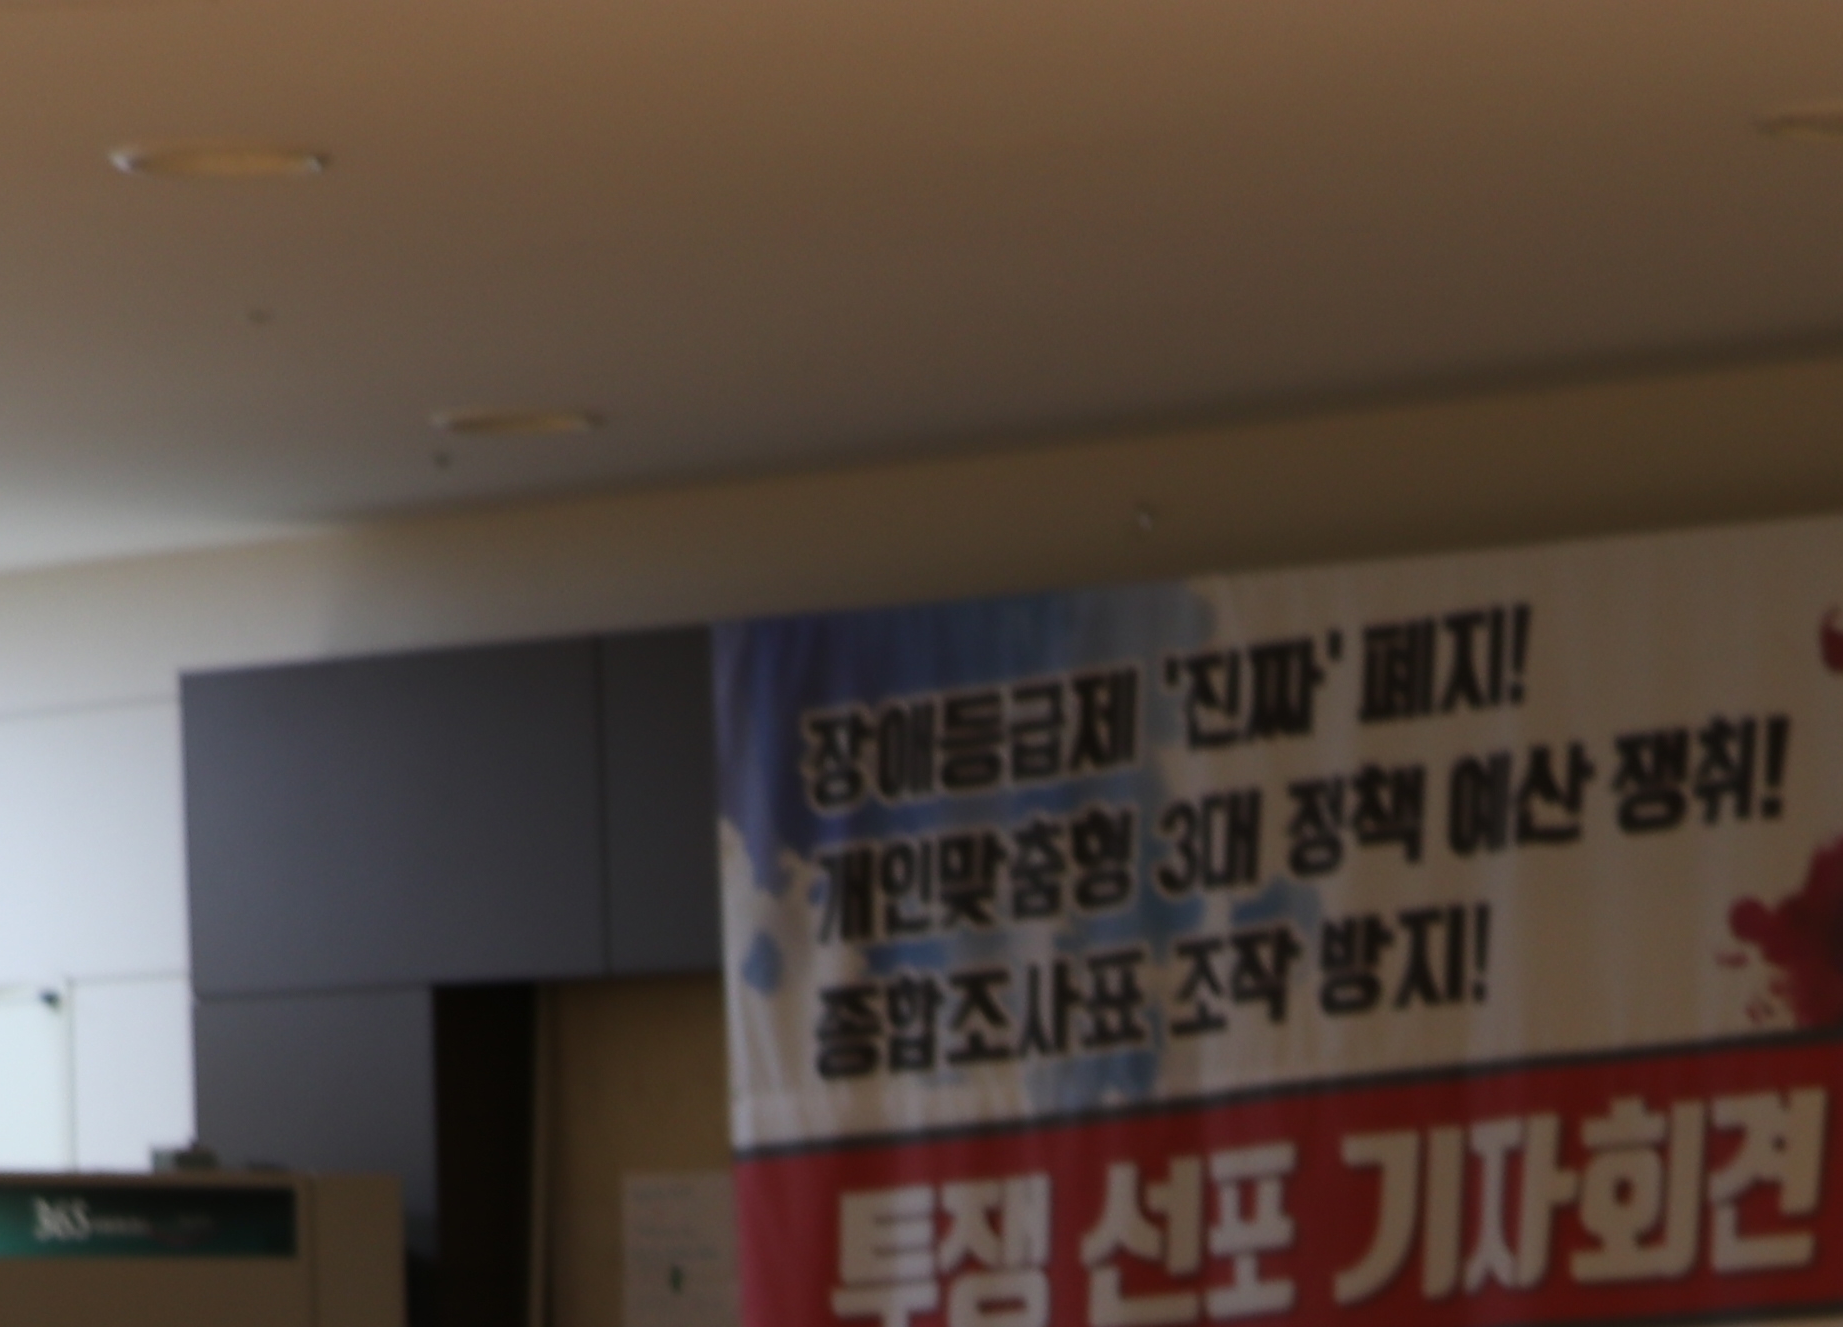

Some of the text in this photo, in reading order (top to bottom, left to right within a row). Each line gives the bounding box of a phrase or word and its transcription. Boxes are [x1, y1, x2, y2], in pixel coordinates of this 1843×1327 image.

[802, 606, 1530, 806] 장애등급제 '진짜' 폐지!
[819, 717, 1789, 943] 개인맞춤형 3대 정책 예산 쟁취!
[816, 905, 1490, 1080] 종합조사표 조작 방지!
[1335, 1088, 1827, 1302] 기자회견
